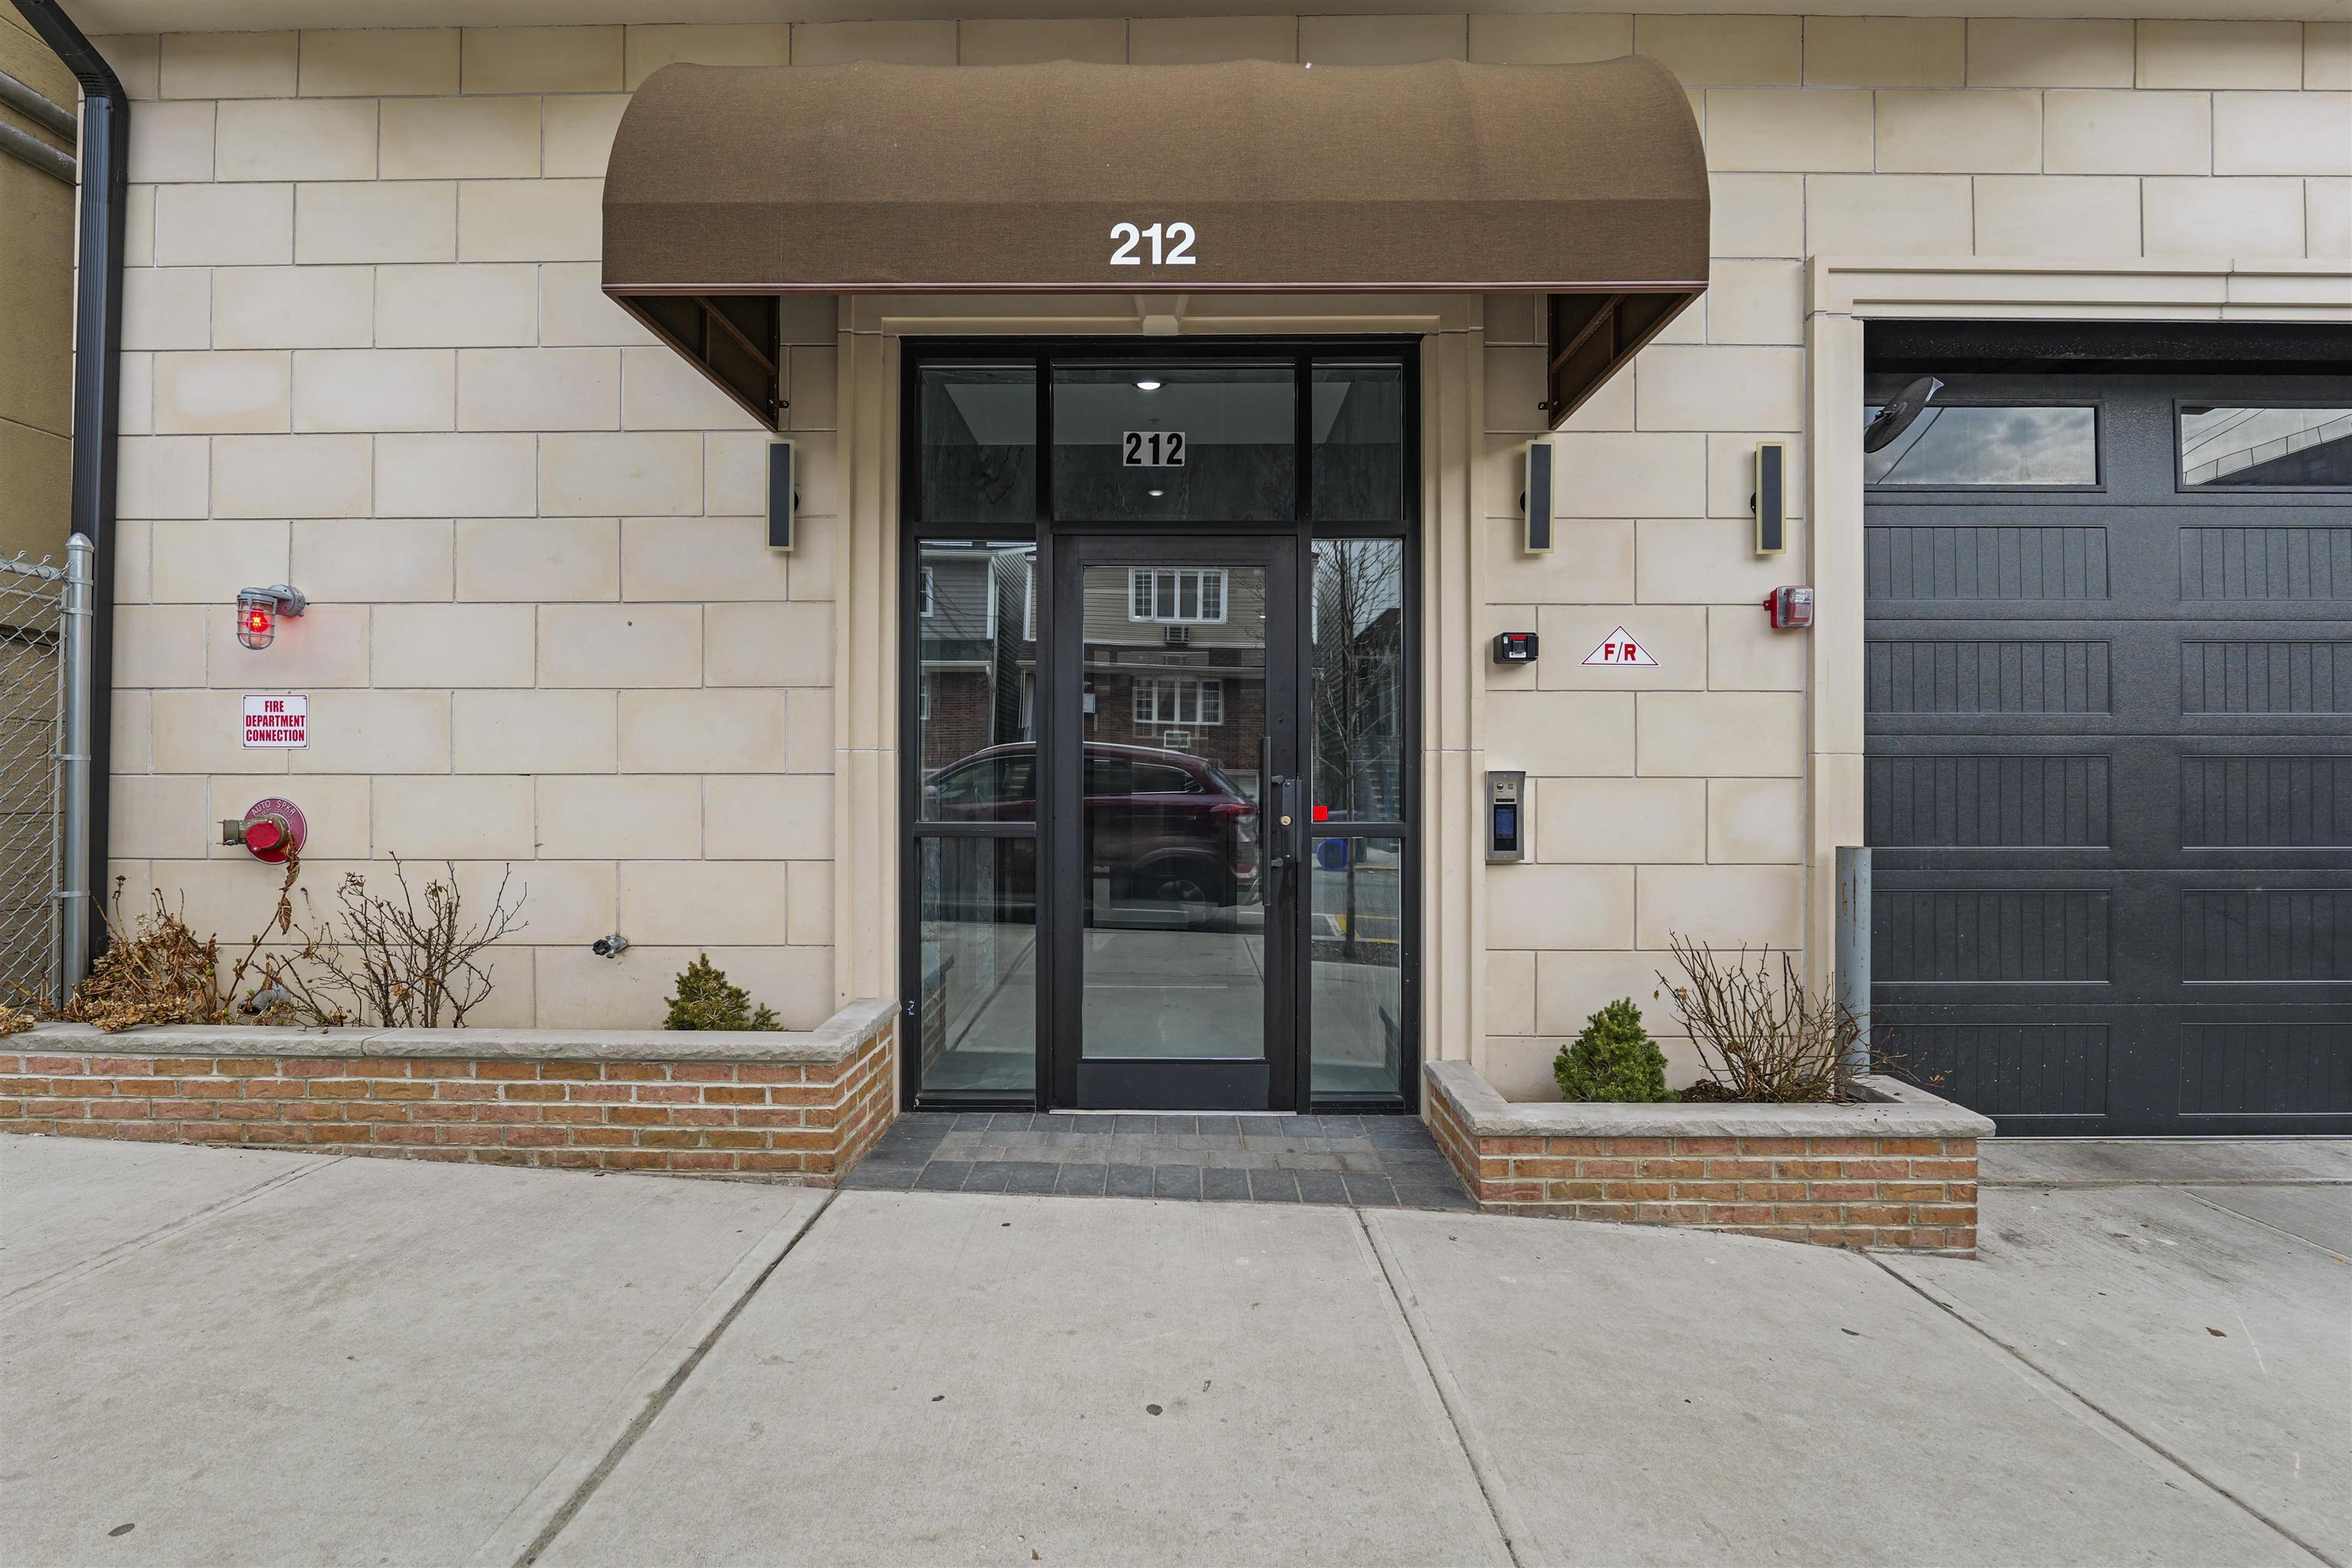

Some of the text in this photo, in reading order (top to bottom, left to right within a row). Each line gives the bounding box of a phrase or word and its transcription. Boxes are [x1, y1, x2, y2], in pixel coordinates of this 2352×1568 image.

[1110, 222, 1196, 265] 212
[1125, 433, 1183, 465] 212
[1604, 642, 1636, 662] F/R
[265, 701, 284, 712] FIRE
[246, 715, 305, 727] DEPARTMENT
[246, 730, 305, 741] CONNECTION
[251, 799, 296, 816] AUTO SPKR
